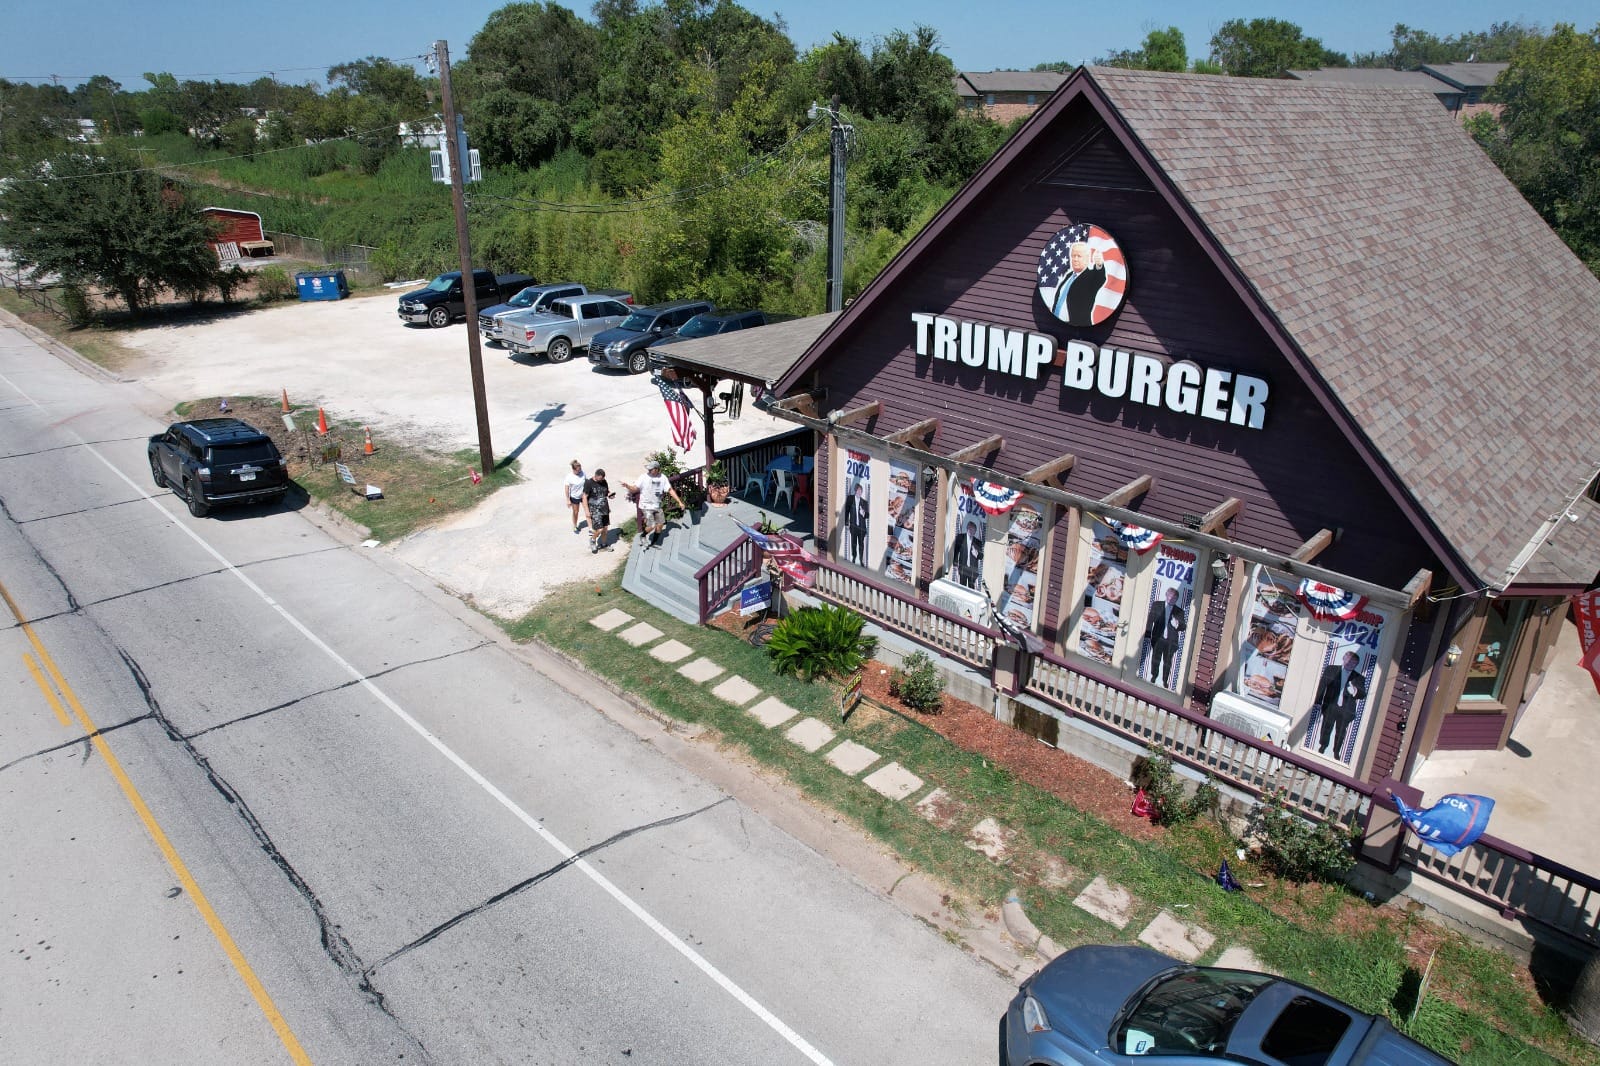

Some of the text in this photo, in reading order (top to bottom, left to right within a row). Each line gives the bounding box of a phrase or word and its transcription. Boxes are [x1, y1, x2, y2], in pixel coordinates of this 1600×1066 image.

[911, 312, 1271, 430] TRUMP BURGER
[848, 449, 871, 463] TRUMP
[846, 459, 871, 481] 2024
[958, 495, 987, 519] 2024
[1161, 544, 1196, 564] TRUMP
[1156, 558, 1194, 585] 2024
[1355, 611, 1384, 627] UMP
[1333, 621, 1379, 649] 2024
